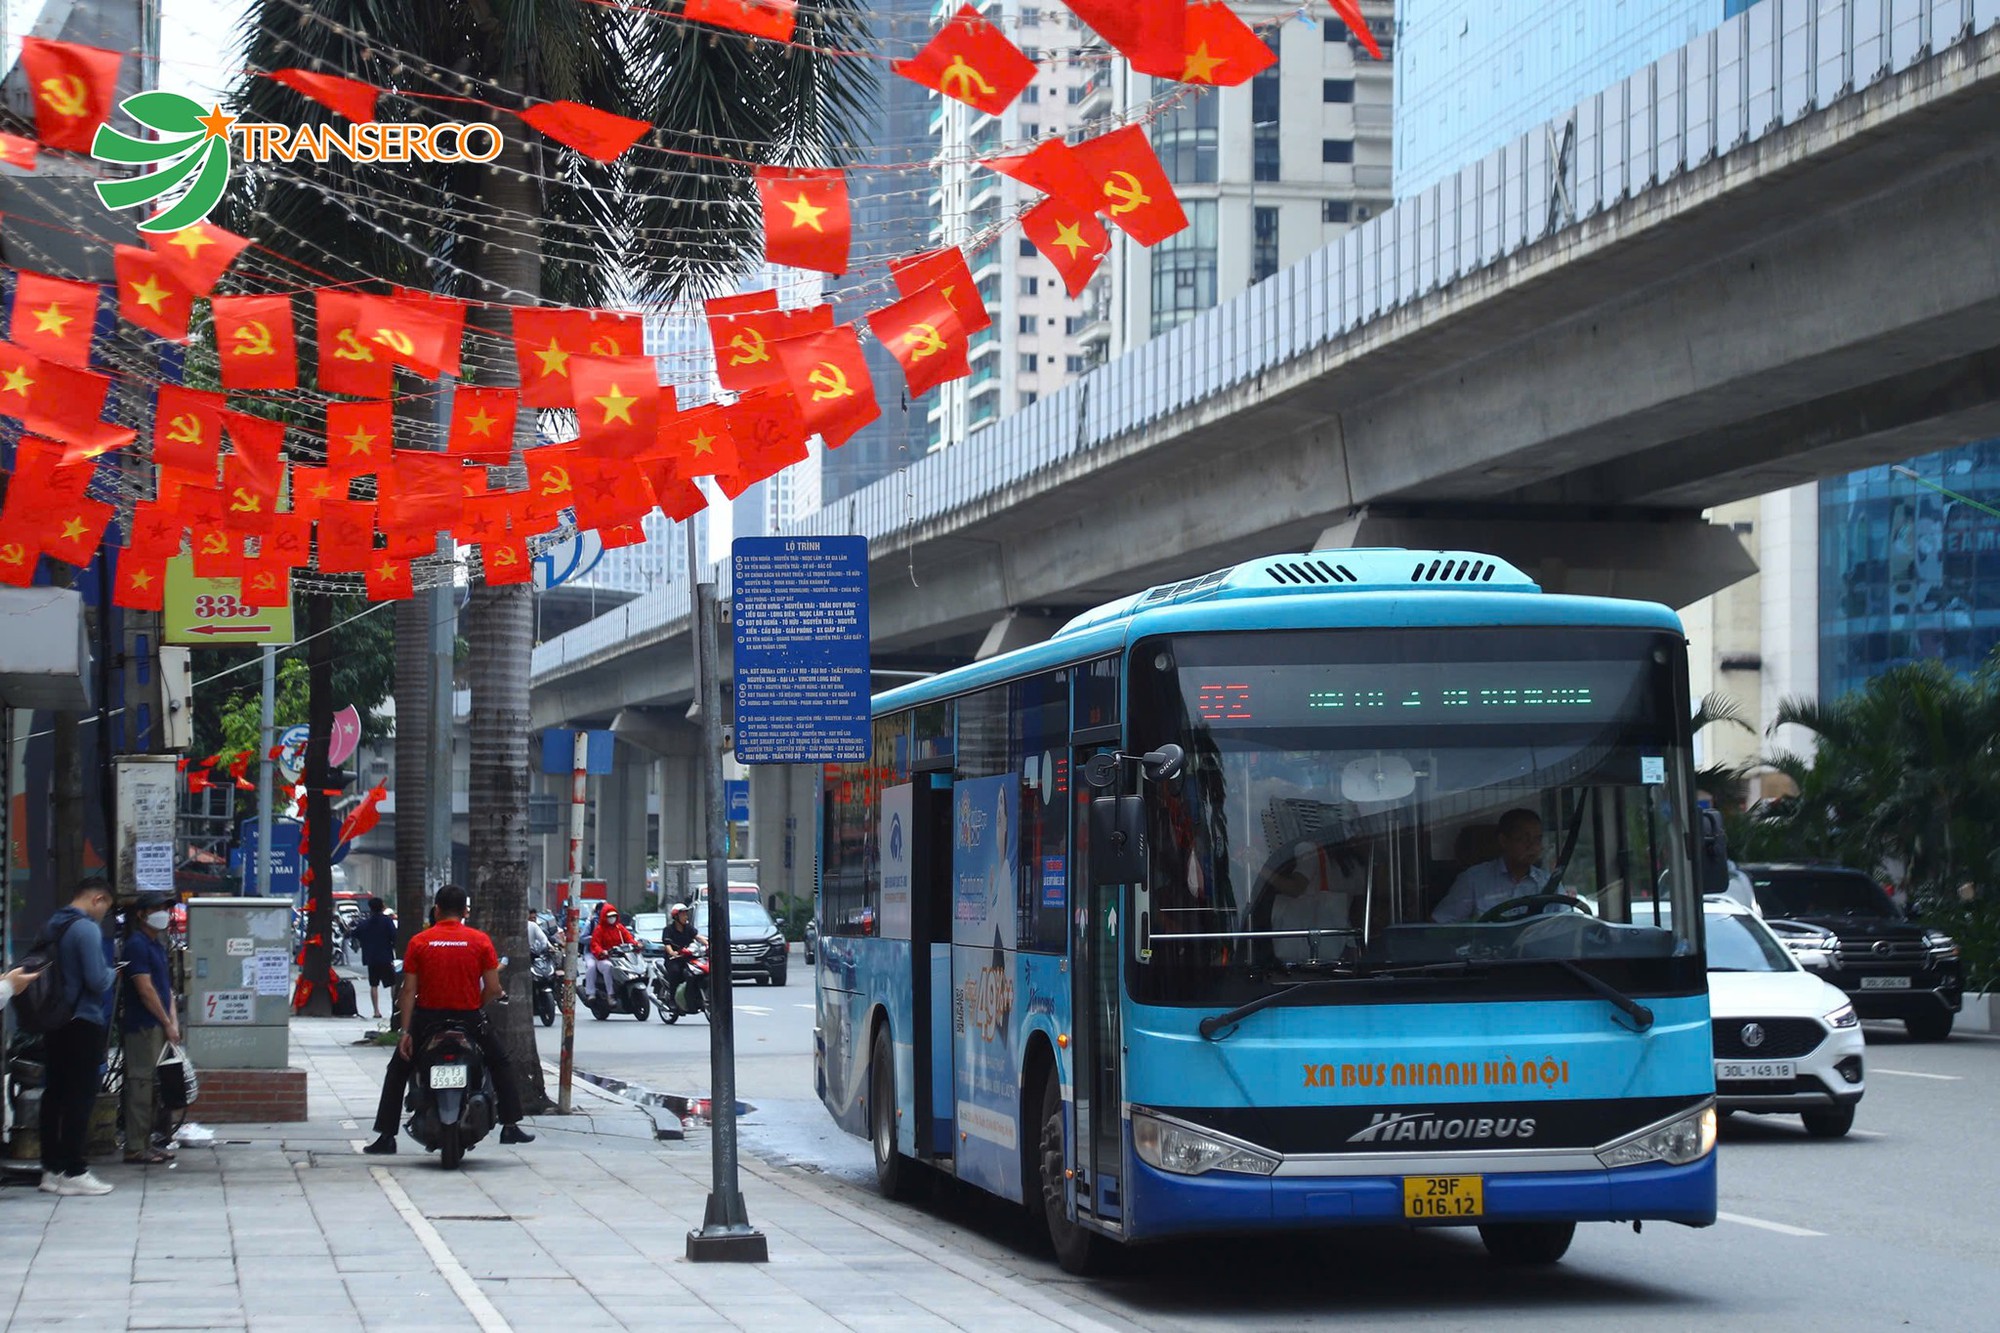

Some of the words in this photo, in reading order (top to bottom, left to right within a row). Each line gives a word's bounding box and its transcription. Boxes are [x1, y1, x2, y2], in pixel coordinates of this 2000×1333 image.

[785, 540, 795, 553] LỘ
[797, 540, 821, 551] TRÌNH
[1199, 685, 1251, 719] 02
[432, 1077, 464, 1087] 359.58
[1342, 1064, 1386, 1086] BUS
[1391, 1063, 1477, 1085] NHANH
[1485, 1056, 1517, 1085] HÀ
[1522, 1056, 1569, 1090] NỘI
[1346, 1112, 1537, 1143] HANOIBUS
[1426, 1178, 1460, 1196] 29F
[1413, 1197, 1475, 1215] 016.12
